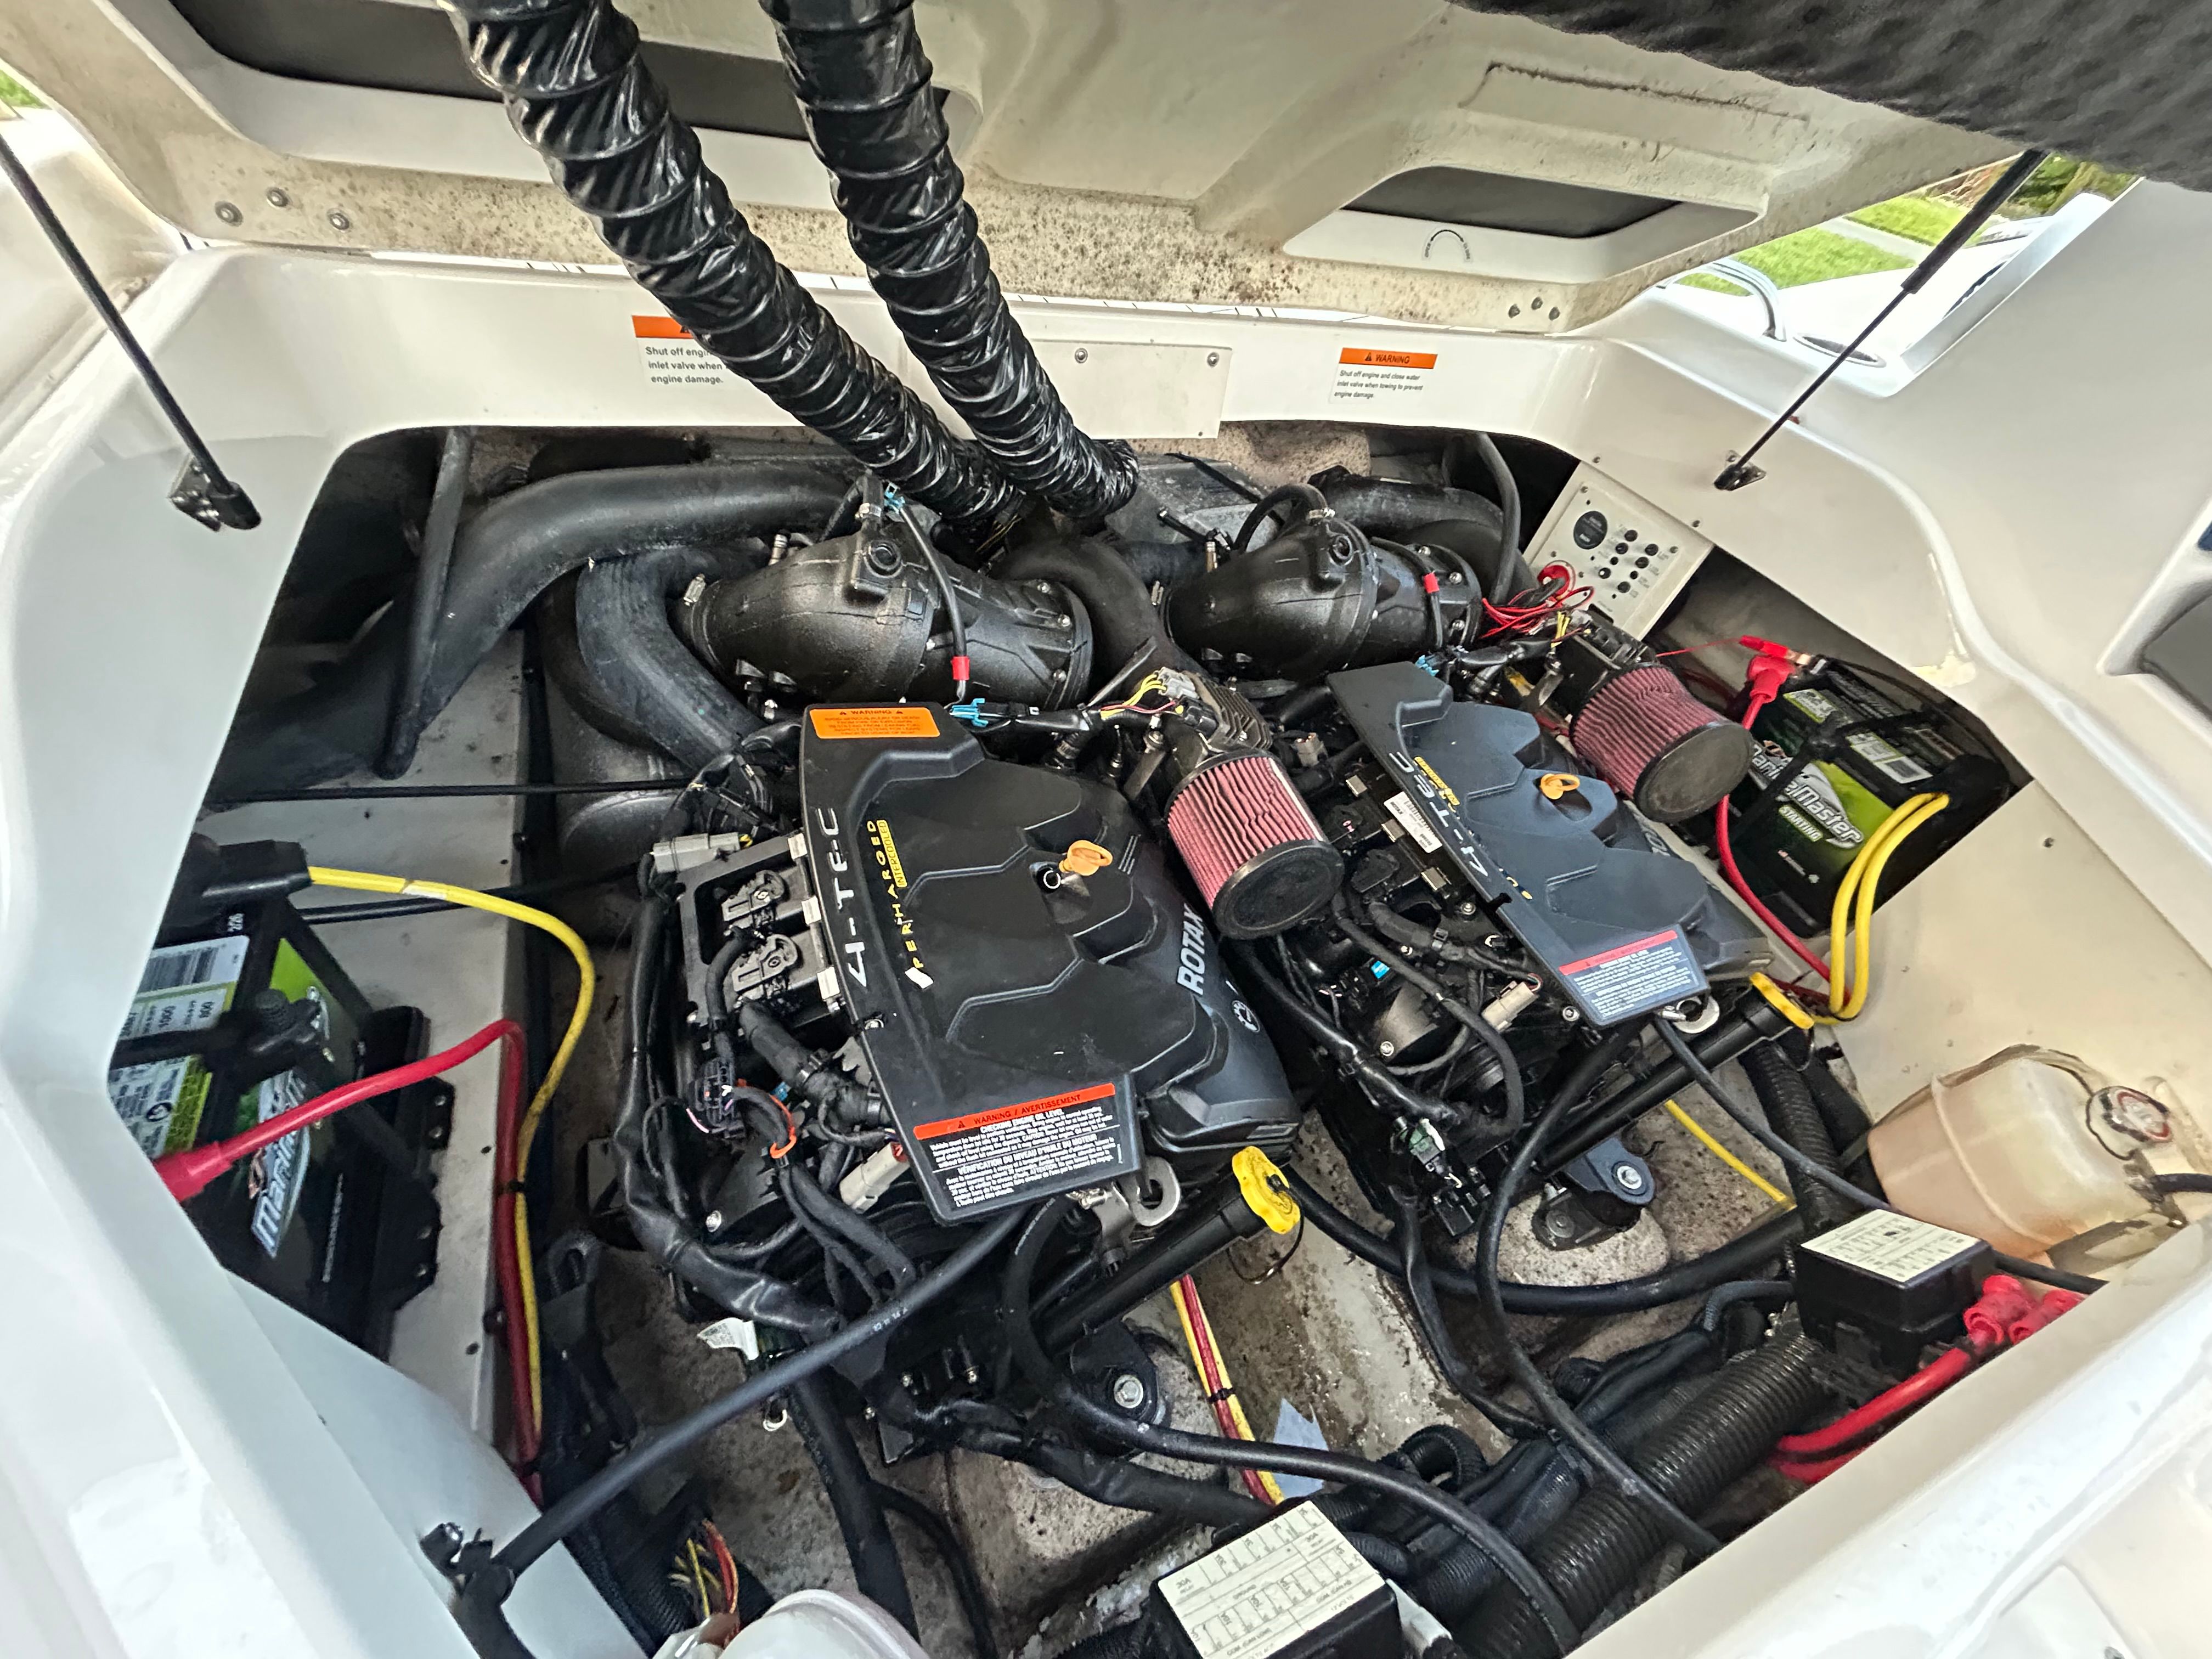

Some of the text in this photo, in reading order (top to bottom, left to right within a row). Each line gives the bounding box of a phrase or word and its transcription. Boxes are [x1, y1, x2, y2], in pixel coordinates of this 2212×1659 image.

[645, 346, 713, 357] Shut off engi
[648, 362, 669, 370] inlet
[698, 362, 723, 370] when
[1375, 354, 1410, 364] WARNING
[651, 375, 724, 385] engine damage.
[1793, 785, 1864, 843] Master
[878, 821, 907, 887] INTERCOOLED
[817, 807, 867, 988] 4-TEC
[1177, 902, 1205, 996] ROTAX
[973, 1110, 1011, 1125] WARNING
[1020, 1094, 1081, 1114] AVERTISSEMENT
[979, 1120, 1012, 1134] CHECKING
[1045, 1108, 1064, 1118] LEVEL
[957, 1156, 1003, 1176] VÉRIFICATION
[1071, 1133, 1098, 1146] MOTEUR
